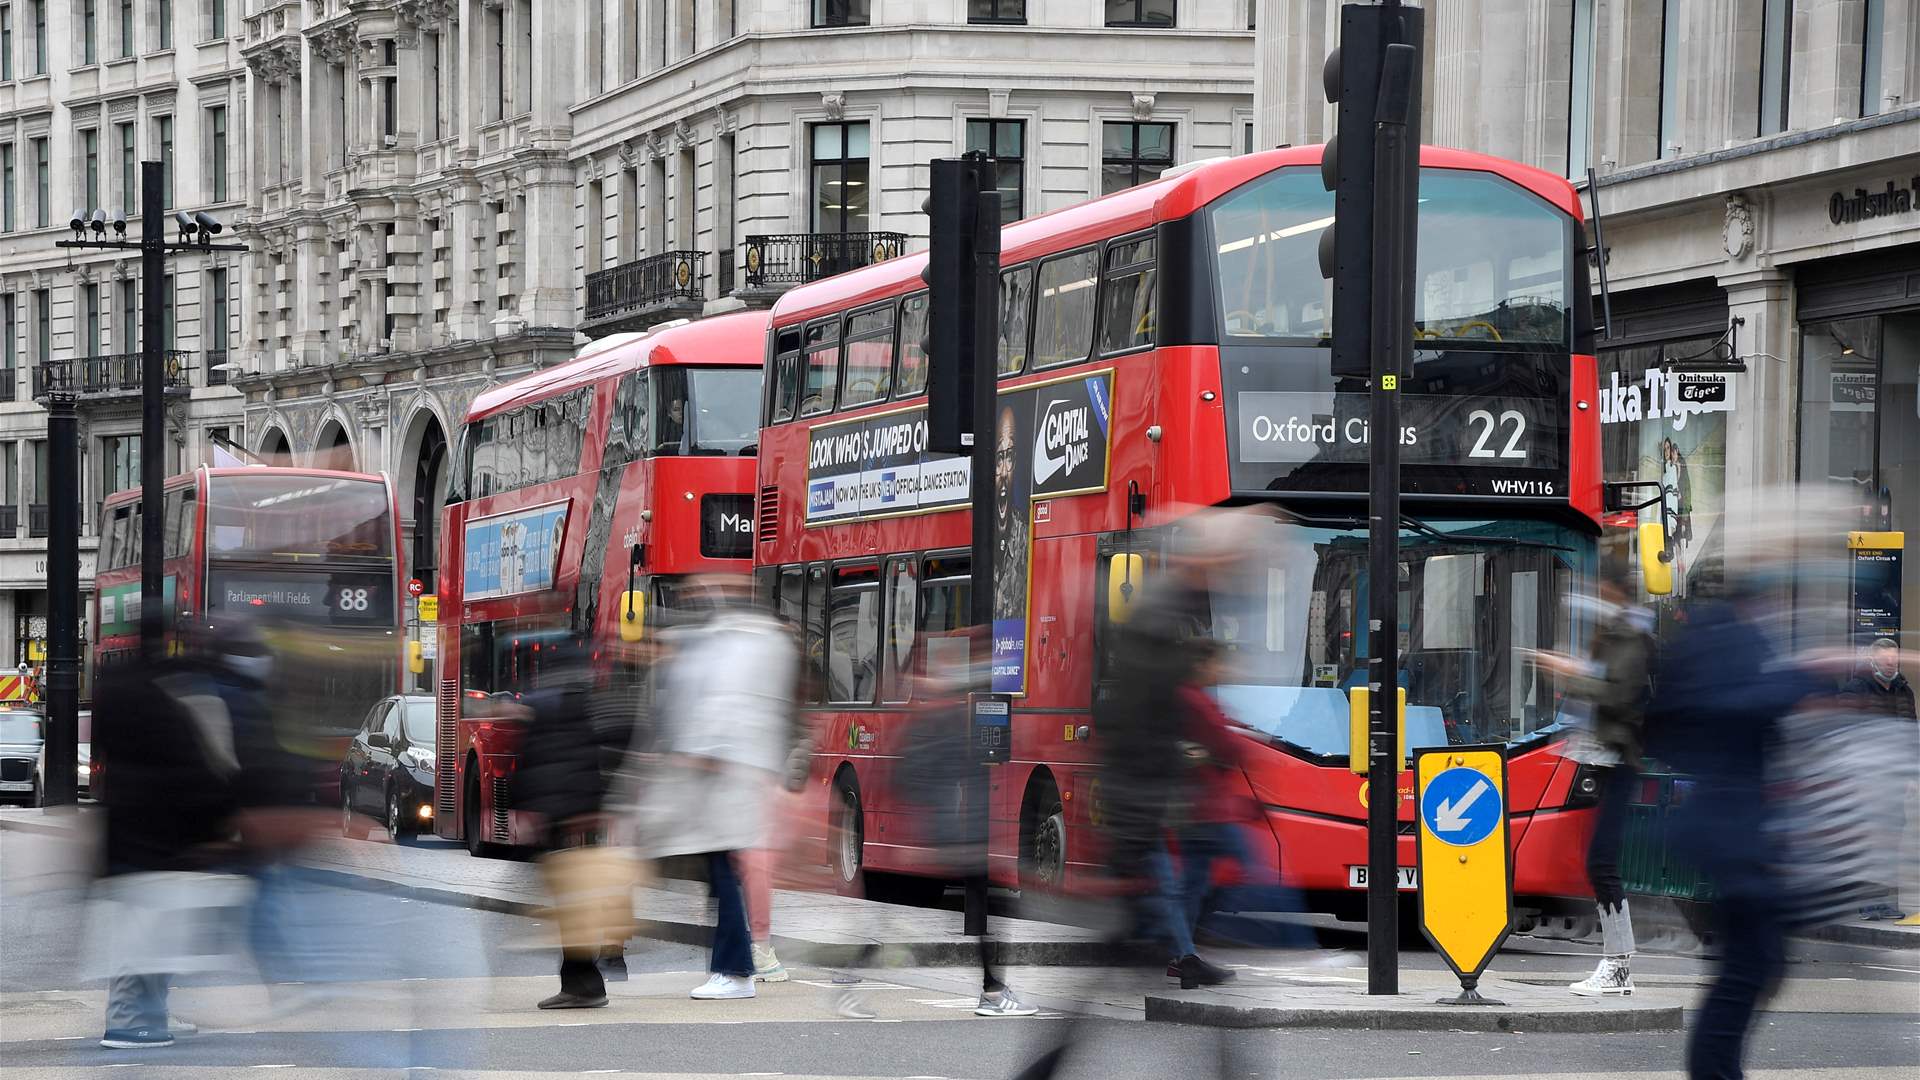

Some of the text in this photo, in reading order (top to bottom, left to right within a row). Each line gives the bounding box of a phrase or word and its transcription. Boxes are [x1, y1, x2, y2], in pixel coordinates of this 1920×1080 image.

[1829, 181, 1911, 225] Onitsuka
[1678, 373, 1726, 383] Onitsuka
[1684, 385, 1719, 399] Tiger
[1047, 406, 1088, 450] CAPITAL
[1252, 415, 1417, 445] Oxford Cius
[1468, 409, 1527, 458] 22
[809, 437, 834, 469] LOOK
[835, 429, 870, 464] WHO'S
[870, 423, 912, 459] JUMPED
[1065, 442, 1088, 477] DANCE
[835, 487, 849, 503] NOW
[849, 485, 858, 501] ON
[860, 482, 869, 500] THE
[869, 480, 881, 499] UK'S
[882, 479, 895, 498] NEW
[895, 476, 922, 495] OFFICIAL
[923, 474, 943, 491] DANCE
[943, 469, 969, 488] STATION
[1491, 479, 1554, 495] WHV116
[228, 590, 270, 603] Parliament
[287, 592, 311, 605] Fields
[339, 588, 368, 611] 88
[409, 583, 422, 591] RC
